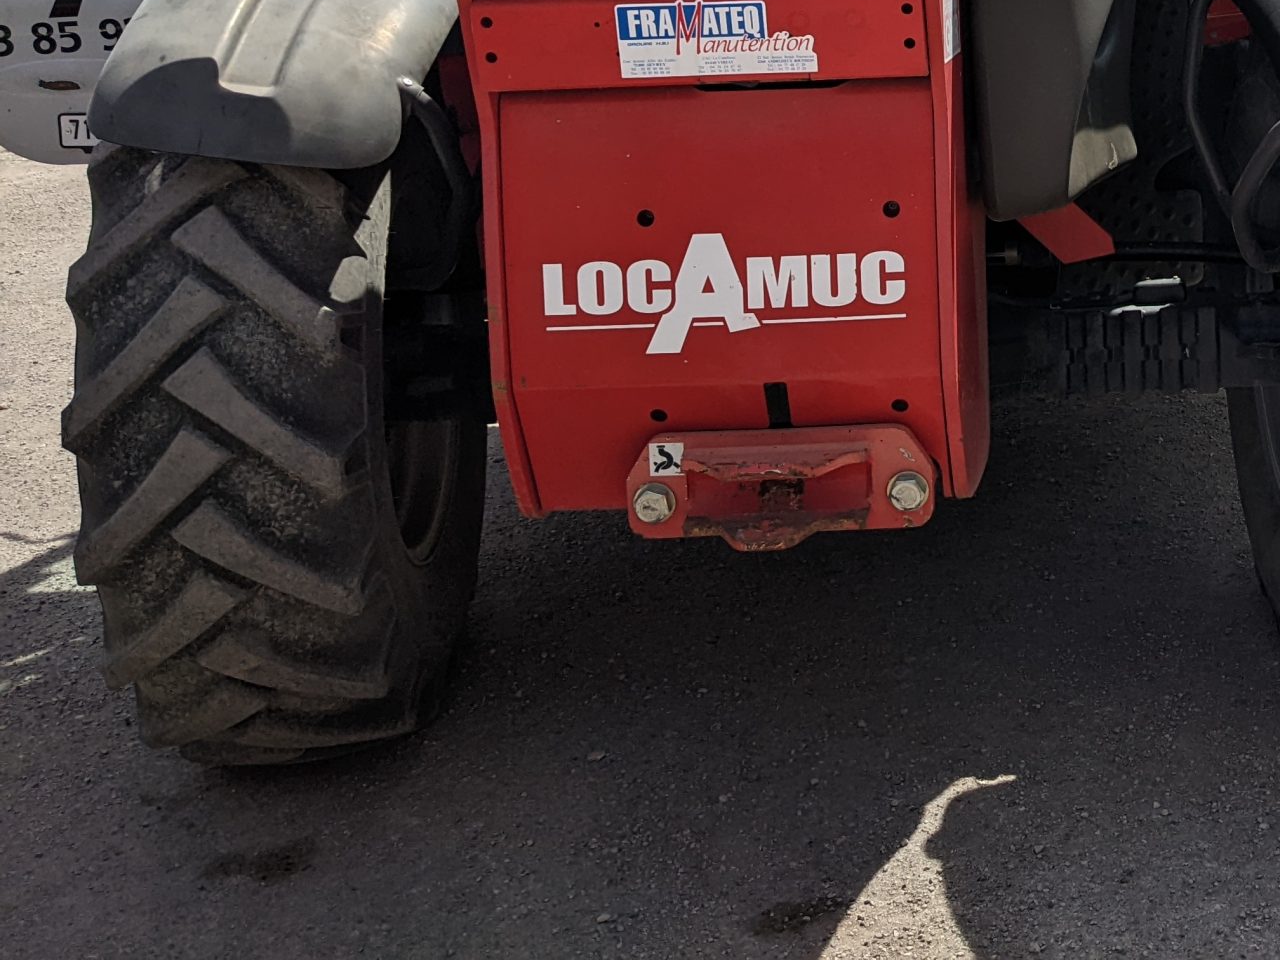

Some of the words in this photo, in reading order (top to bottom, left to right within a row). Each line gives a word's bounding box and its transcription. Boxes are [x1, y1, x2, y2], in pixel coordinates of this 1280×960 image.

[31, 21, 82, 55] 85
[99, 17, 131, 52] 9
[626, 1, 761, 55] FRAMATEQ
[69, 119, 91, 140] 71
[541, 233, 907, 354] LOCAMUC
